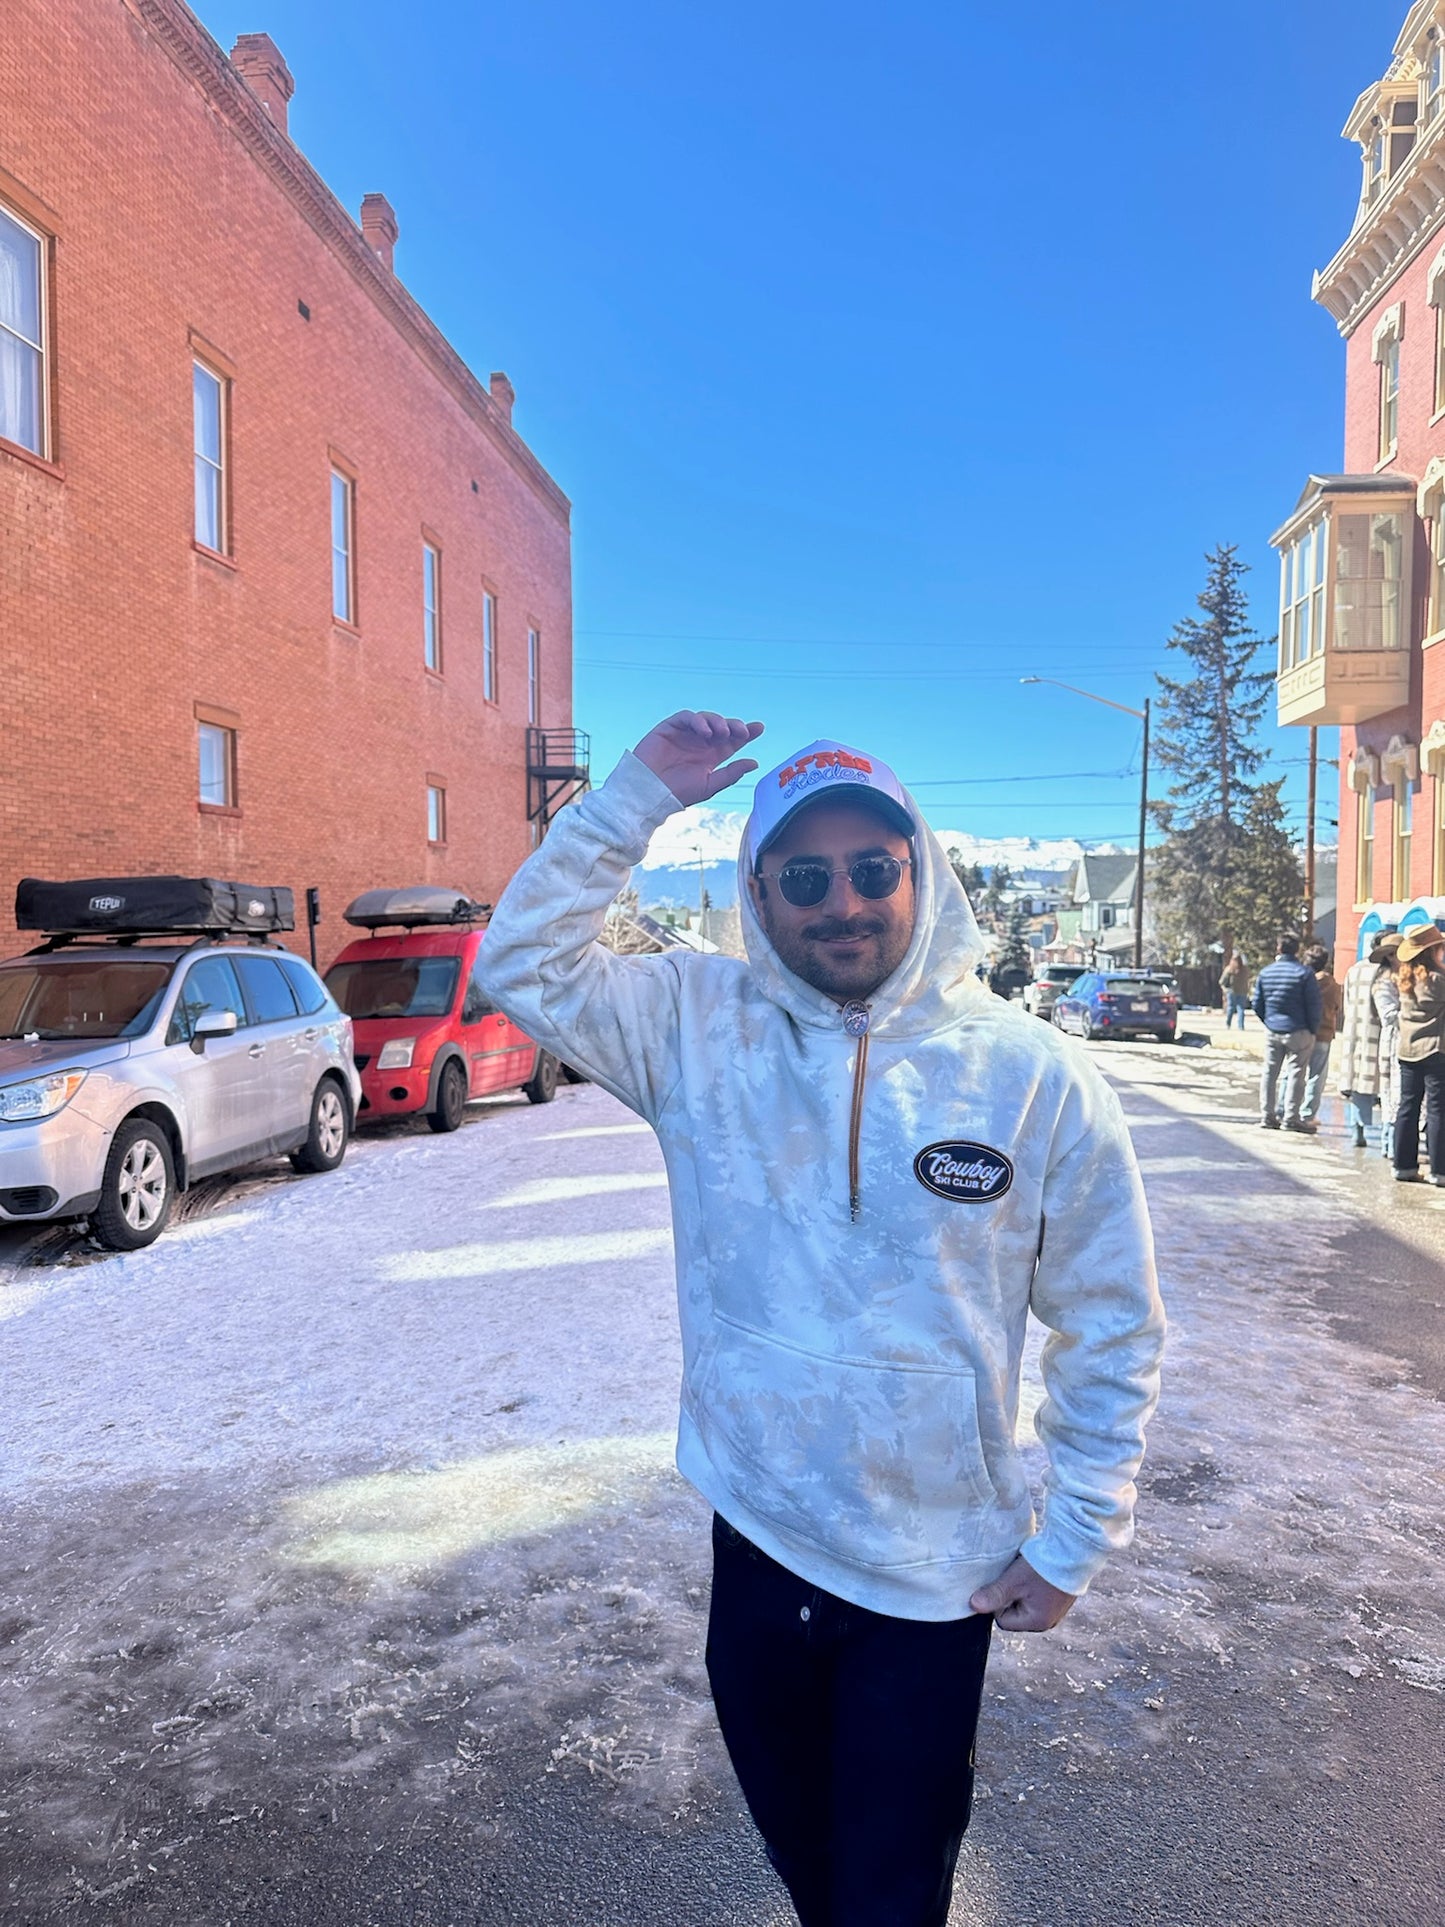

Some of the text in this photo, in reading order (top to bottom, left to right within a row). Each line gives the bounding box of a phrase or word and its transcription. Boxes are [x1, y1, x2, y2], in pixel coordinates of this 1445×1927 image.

[95, 897, 120, 910] TEPUI
[928, 1153, 1005, 1191] Cowboy
[934, 1175, 980, 1189] SKI CLUB
